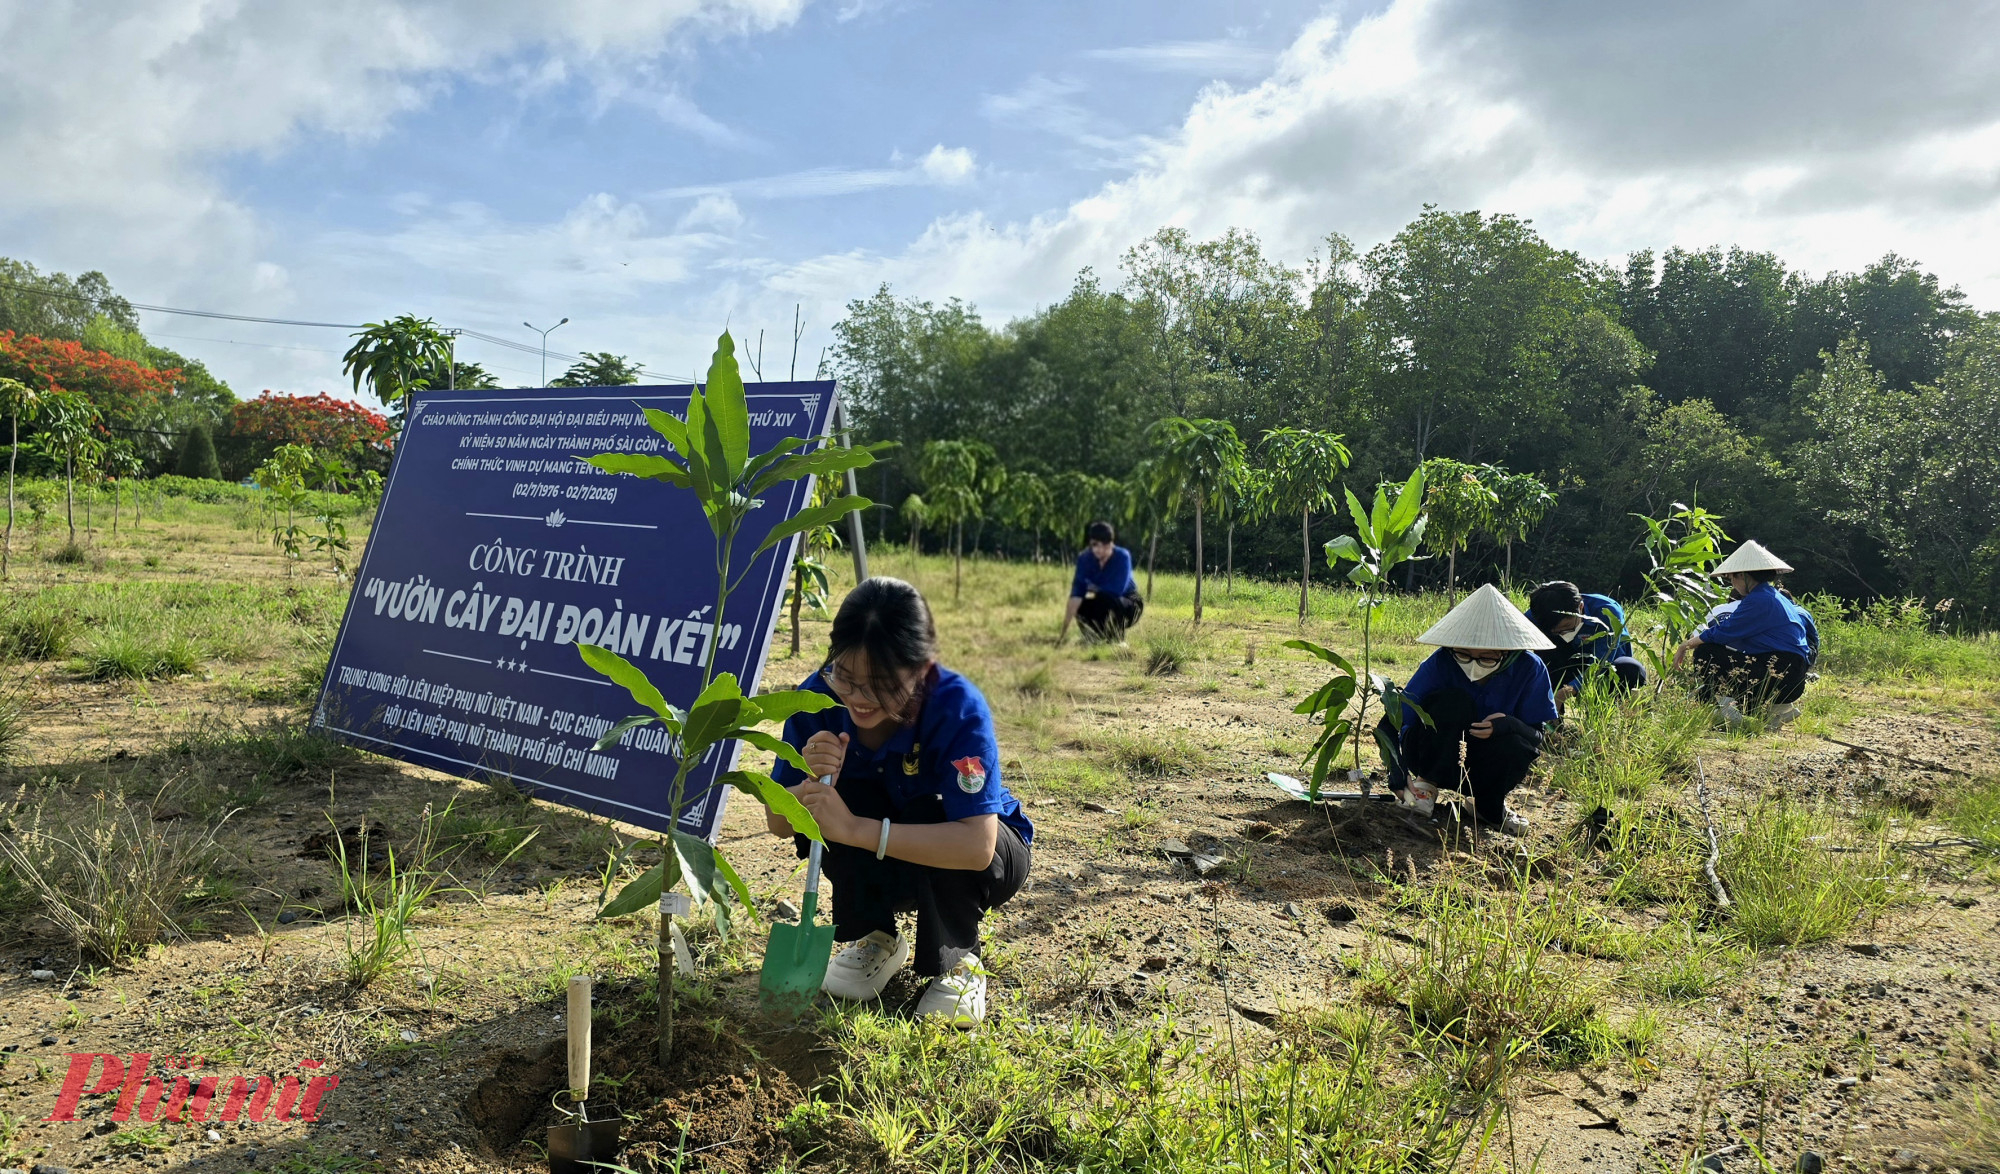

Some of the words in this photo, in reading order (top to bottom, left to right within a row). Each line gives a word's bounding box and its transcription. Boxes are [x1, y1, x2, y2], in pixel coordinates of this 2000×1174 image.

[421, 411, 446, 426] CHÀO
[445, 411, 472, 426] MỪNG
[472, 411, 503, 426] THÀNH
[502, 410, 529, 426] CÔNG
[529, 413, 547, 429] ĐẠI
[547, 410, 566, 429] HỘI
[566, 413, 585, 429] ĐẠI
[585, 409, 610, 426] BIỂU
[610, 413, 634, 430] PHỤ
[773, 413, 797, 427] XIV
[459, 432, 473, 448] KỶ
[472, 433, 496, 451] NIỆM
[495, 436, 508, 449] 50
[507, 433, 530, 449] NĂM
[529, 433, 557, 450] NGÀY
[557, 434, 592, 451] THÀNH
[592, 433, 617, 451] PHỐ
[615, 435, 634, 451] SÀI
[634, 435, 660, 452] GÒN
[451, 456, 480, 470] CHÍNH
[479, 456, 504, 472] THỨC
[504, 459, 529, 472] VINH
[528, 458, 545, 476] DỰ
[543, 460, 573, 474] MANG
[512, 482, 560, 499] (02/7/1976
[565, 484, 618, 504] 02/7/2026)
[469, 537, 538, 577] CÔNG
[540, 544, 626, 587] TRÌNH
[444, 581, 502, 632] CÂY
[498, 597, 555, 651] ĐẠI
[553, 598, 651, 657] ĐOÀN
[338, 665, 368, 688] TRUNG
[366, 671, 393, 693] ƯƠNG
[390, 674, 410, 699] HỘI
[407, 678, 431, 702] LIÊN
[429, 683, 454, 709] HIỆP
[452, 689, 476, 715] PHỤ
[473, 691, 493, 715] NỮ
[491, 695, 517, 722] VIỆT
[514, 702, 544, 727] NAM
[549, 709, 575, 736] CỤC
[619, 726, 636, 751] RỊ
[634, 727, 671, 756] QUÂN
[382, 704, 402, 729] HỘI
[400, 708, 424, 732] LIÊN
[421, 713, 447, 739] HIỆP
[444, 719, 469, 746] PHỤ
[466, 723, 487, 747] NỮ
[483, 728, 522, 756] THÀNH
[520, 736, 550, 762] PHỐ
[543, 740, 567, 766] HỒ
[562, 747, 588, 772] CHÍ
[584, 753, 620, 780] MINH
